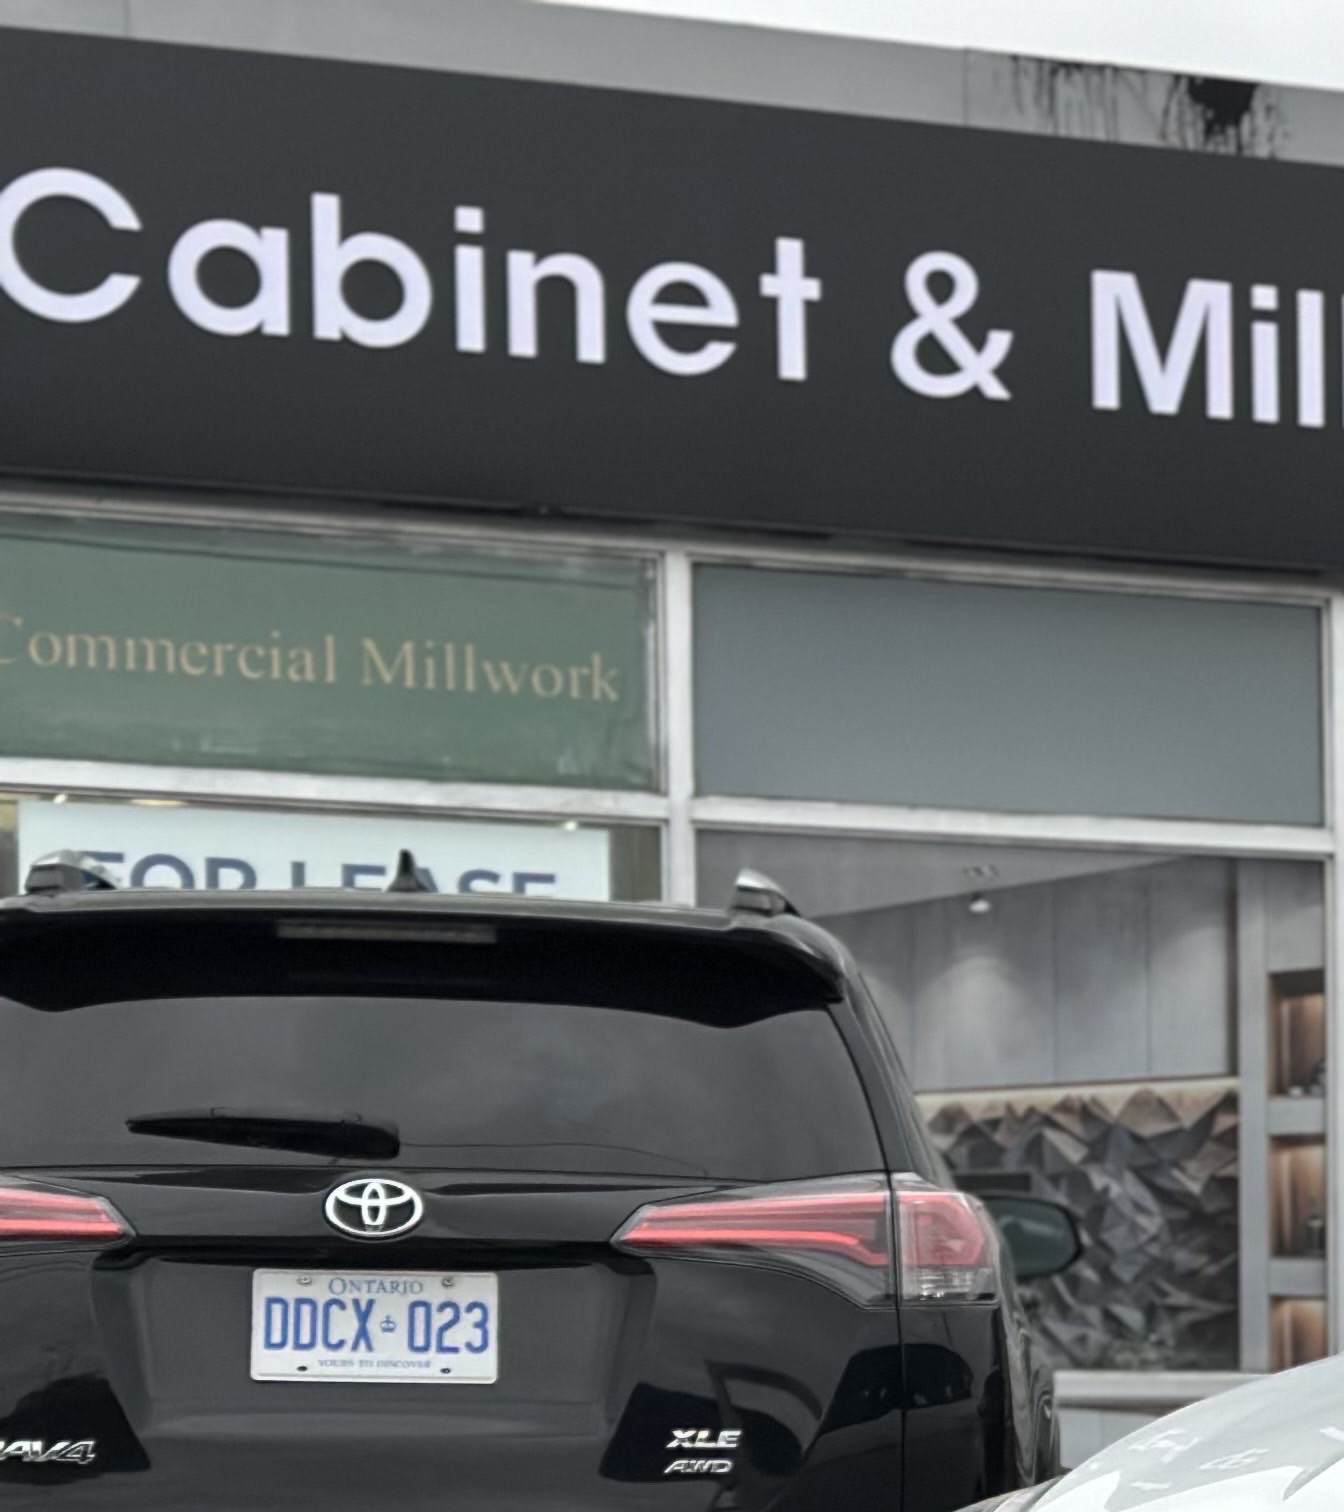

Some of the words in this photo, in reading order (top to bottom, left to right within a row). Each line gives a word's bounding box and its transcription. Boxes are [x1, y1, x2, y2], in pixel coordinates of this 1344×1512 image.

[0, 168, 821, 380] Cabinet
[890, 250, 1014, 400] &
[360, 637, 620, 701] Millwork
[328, 1277, 423, 1295] ONTARIO
[264, 1296, 375, 1352] DDCX
[408, 1300, 489, 1354] 023
[666, 1429, 742, 1448] XLE
[0, 1440, 95, 1465] AV4
[664, 1459, 732, 1474] AWD
